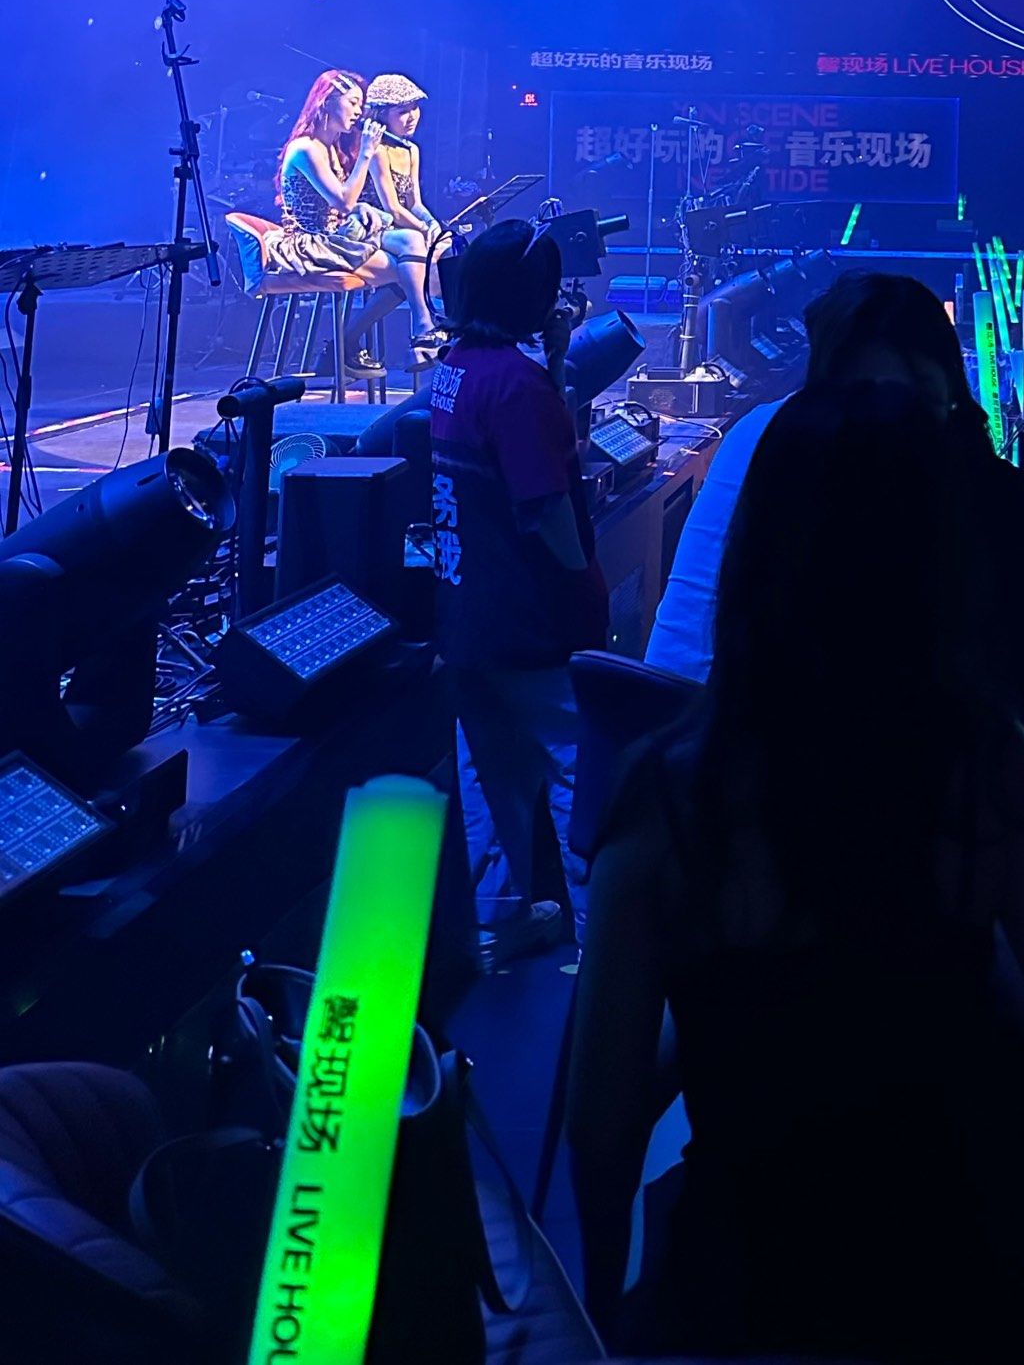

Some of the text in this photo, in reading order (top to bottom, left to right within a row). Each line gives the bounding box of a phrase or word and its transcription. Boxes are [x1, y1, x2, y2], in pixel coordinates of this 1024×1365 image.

[530, 50, 714, 72] 超好玩的音乐现场
[892, 57, 945, 75] LIVE
[736, 102, 840, 127] SCENE
[784, 129, 934, 170] 音乐现场
[765, 167, 831, 193] TIDE
[298, 994, 360, 1153] 馨现场
[280, 1183, 324, 1273] LIVE
